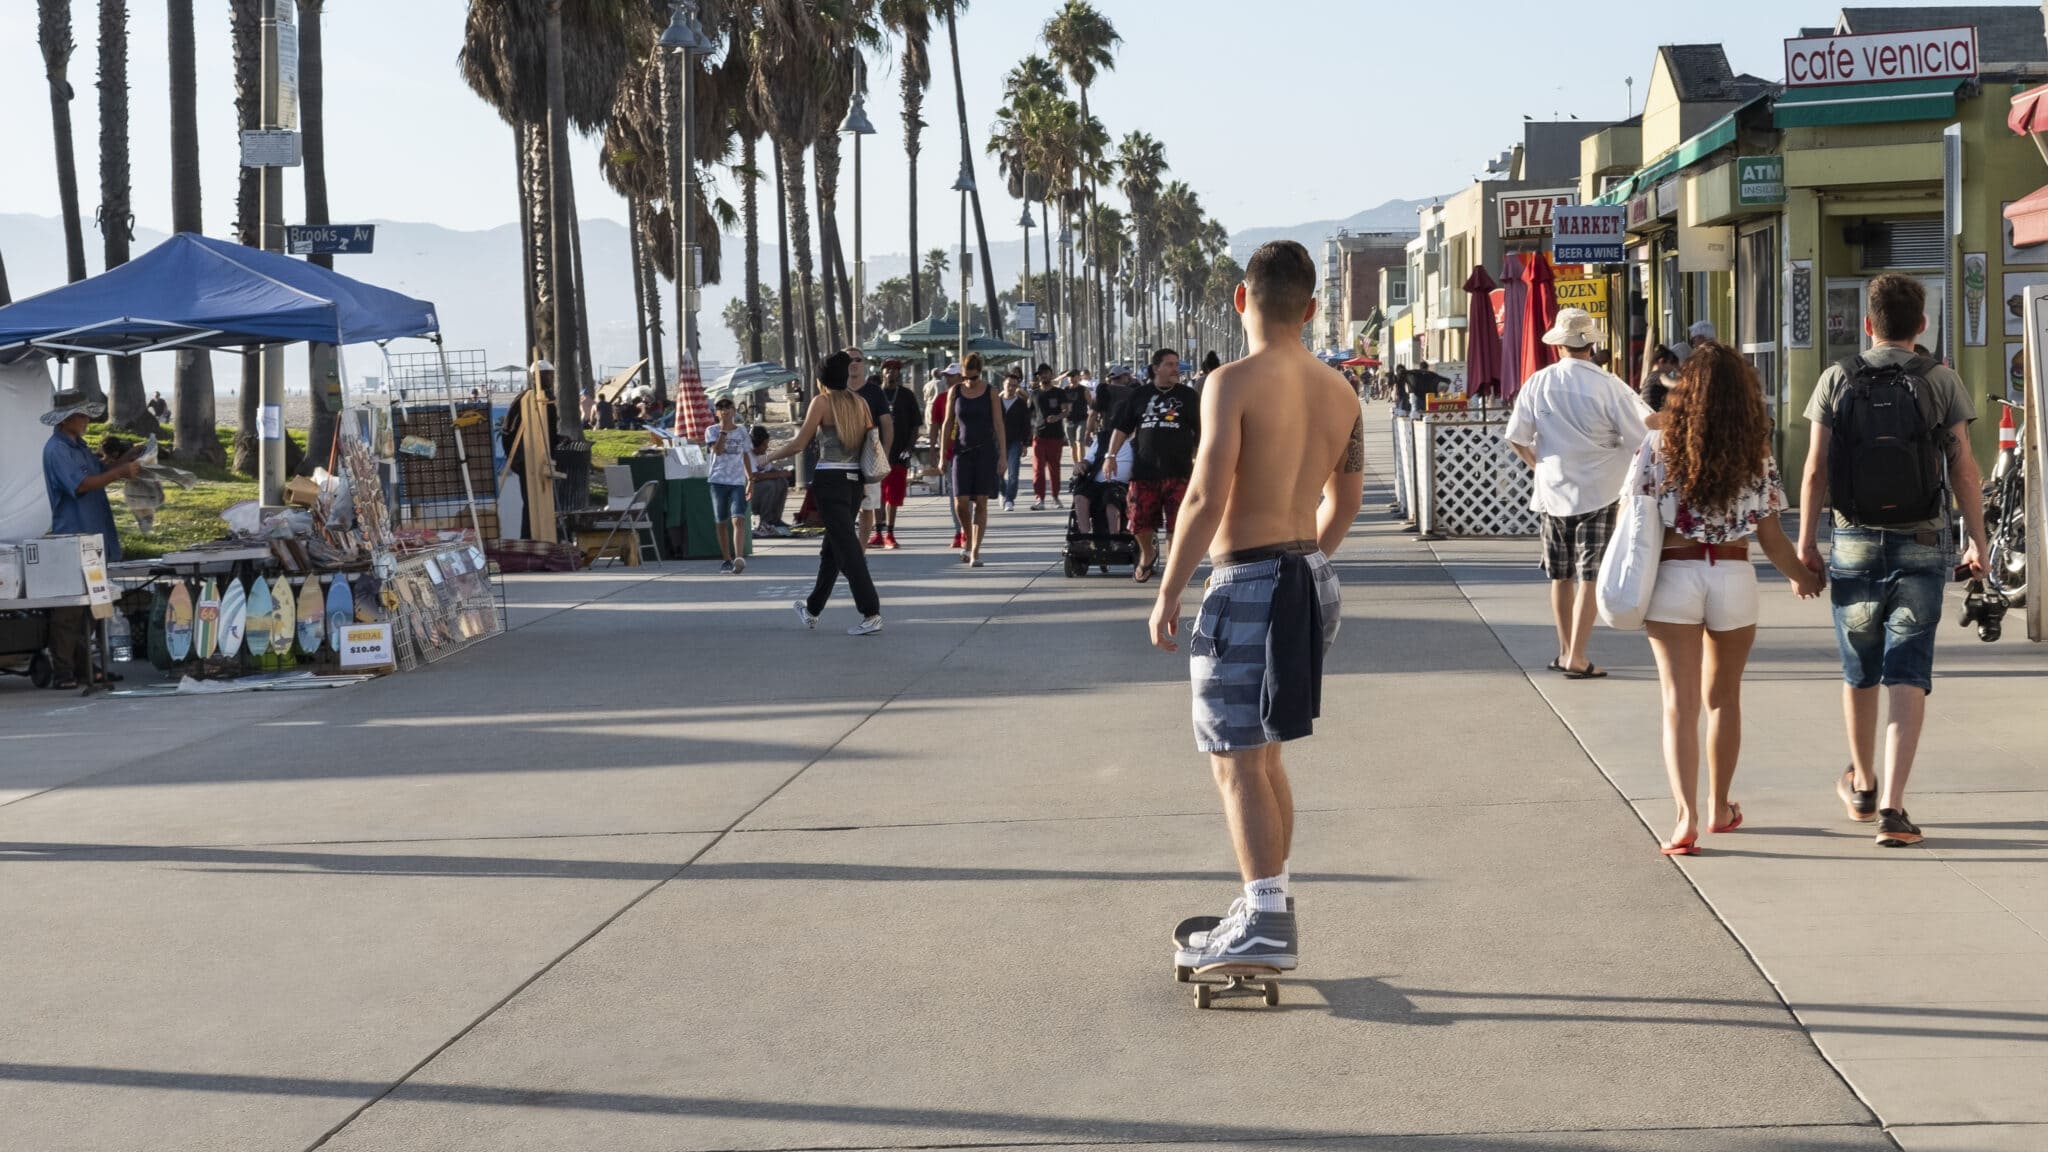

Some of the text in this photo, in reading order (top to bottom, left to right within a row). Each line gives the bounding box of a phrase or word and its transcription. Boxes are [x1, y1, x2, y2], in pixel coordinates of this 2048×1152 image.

[1791, 40, 1971, 82] cafe venicia
[1743, 165, 1782, 181] ATM
[1744, 184, 1783, 195] INSIDE
[1505, 197, 1568, 227] PIZZ
[1558, 216, 1620, 234] MARKET
[291, 227, 369, 241] Brooks Av
[1559, 247, 1620, 259] BEER & WINE
[1556, 283, 1597, 299] OZEN
[201, 608, 216, 620] 66
[350, 645, 381, 654] $10.00
